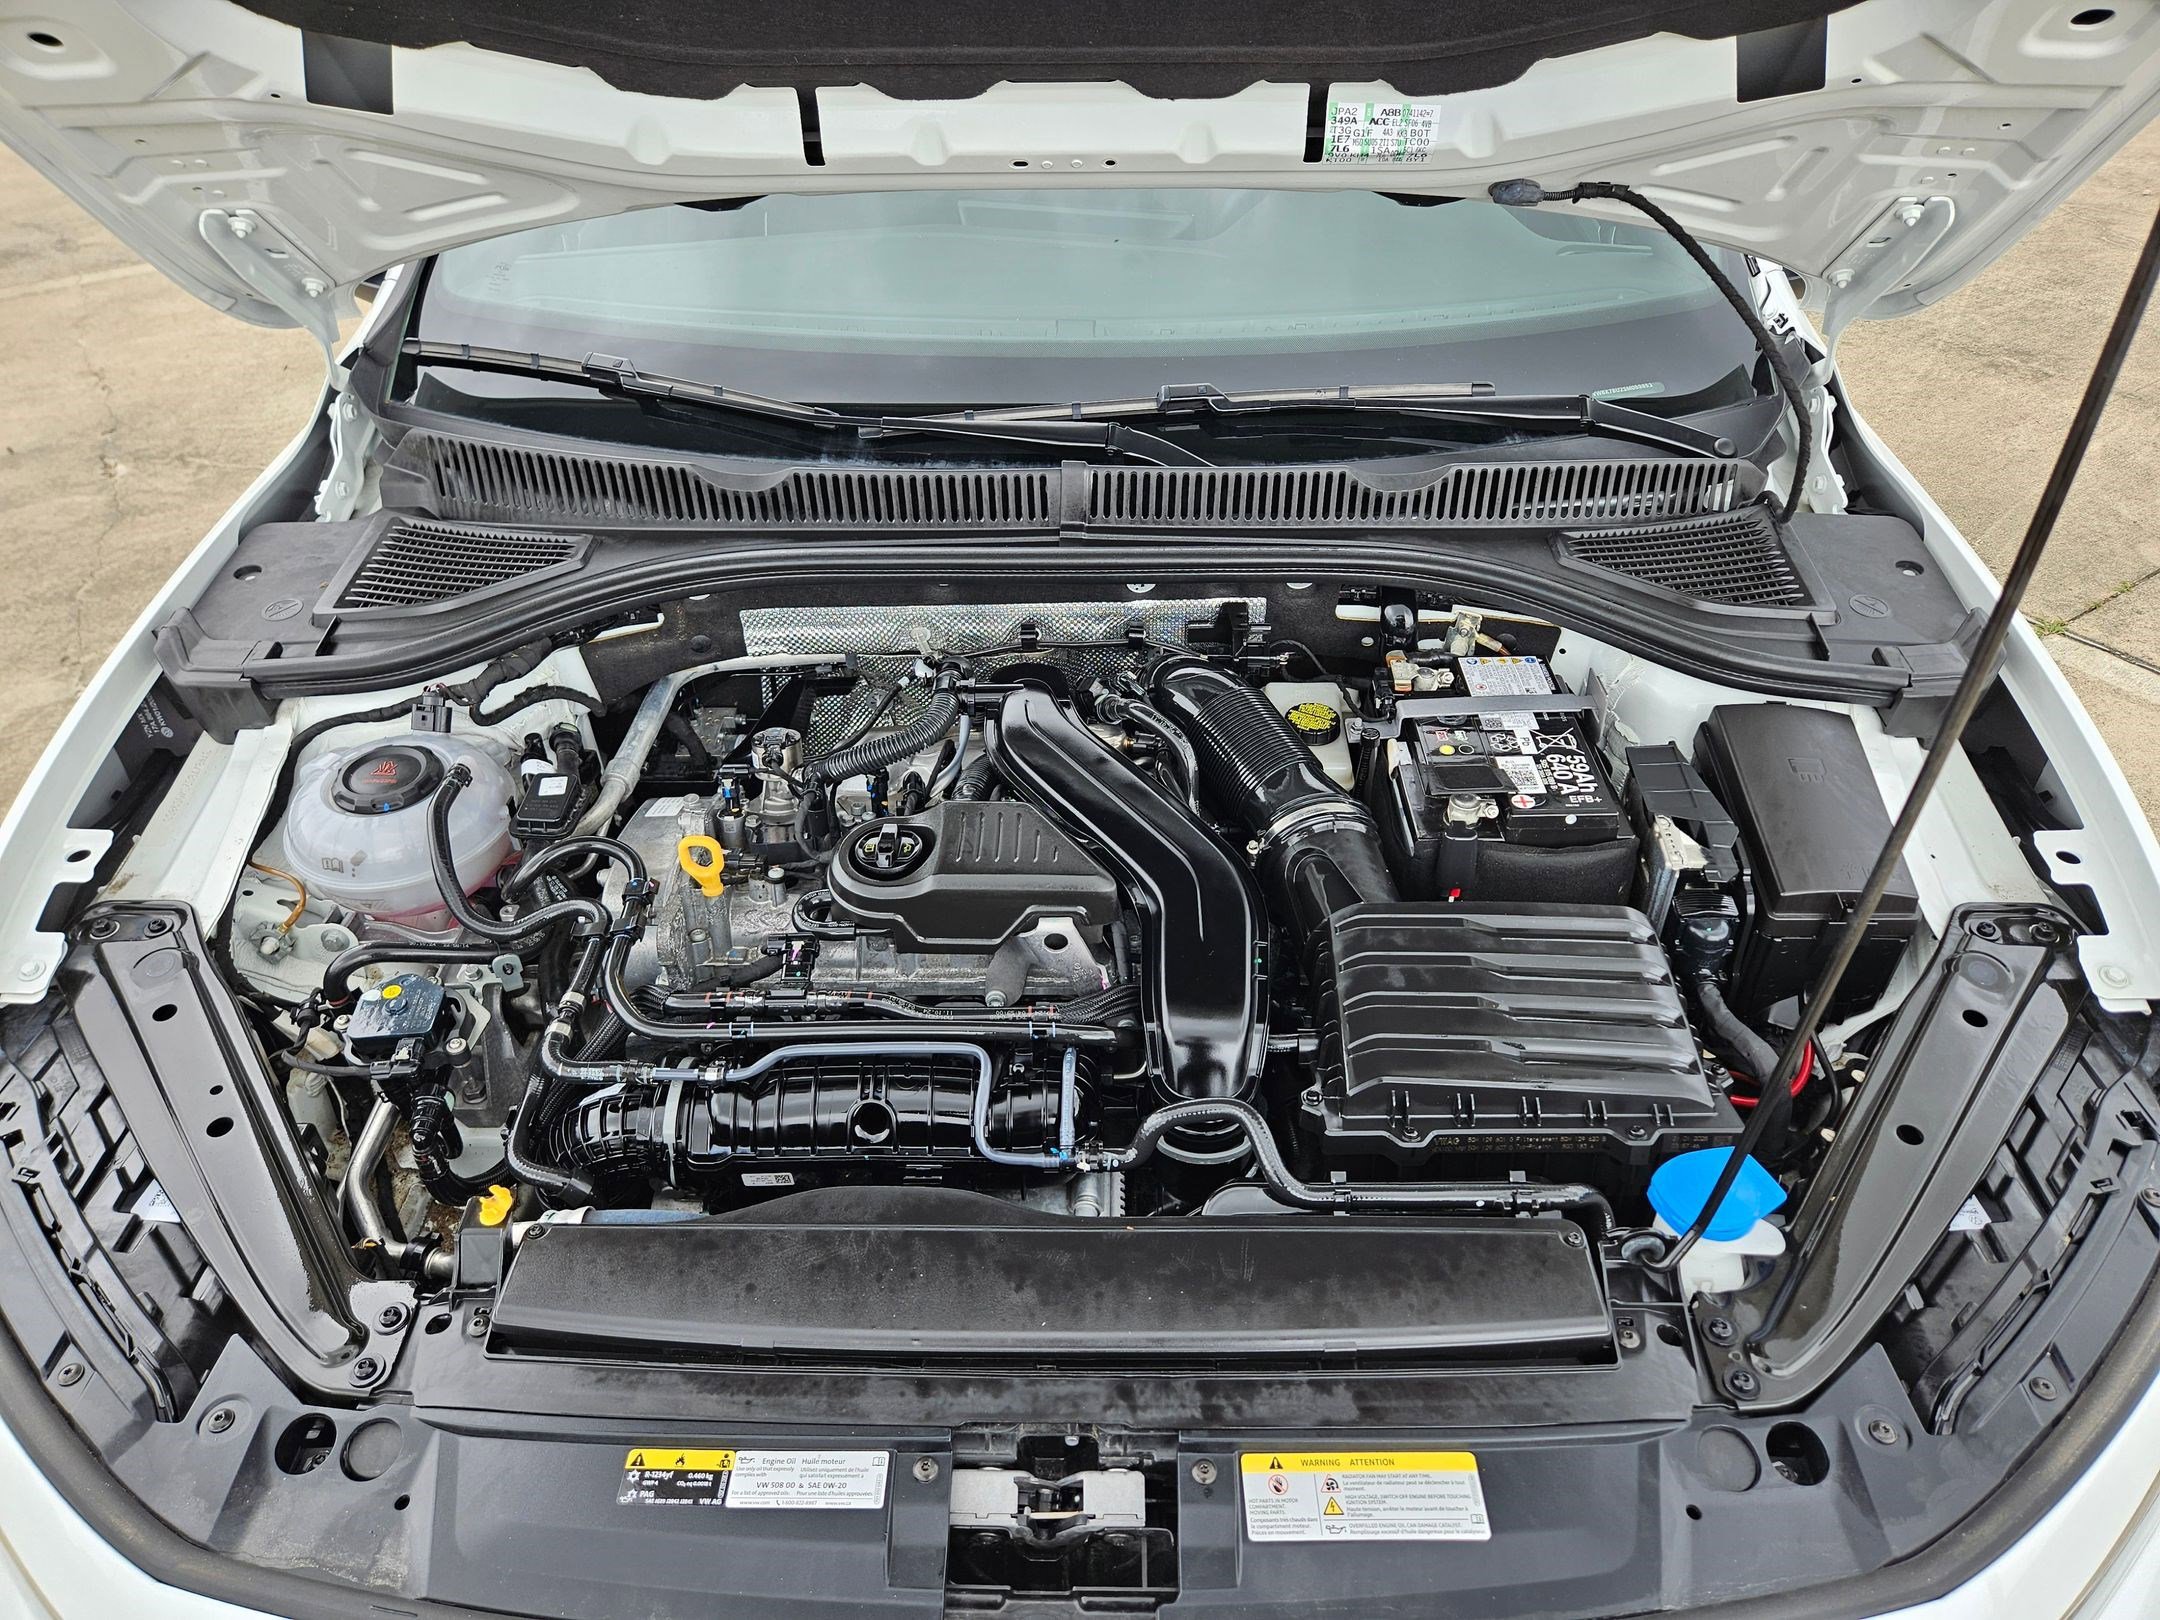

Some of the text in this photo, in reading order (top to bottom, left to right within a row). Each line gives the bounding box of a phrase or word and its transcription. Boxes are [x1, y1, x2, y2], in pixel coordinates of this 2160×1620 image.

[1330, 116, 1358, 125] 349A
[1368, 117, 1390, 126] ACC
[1331, 135, 1351, 144] 1E7
[1330, 145, 1350, 153] 7L6
[1546, 754, 1573, 780] 640
[1566, 754, 1598, 793] 59Ah
[1557, 782, 1580, 795] A
[1569, 795, 1603, 804] EFB+
[762, 1457, 785, 1466] Engine
[787, 1457, 797, 1465] Oil
[801, 1457, 820, 1465] Huile
[1300, 1458, 1395, 1467] WARNING ATTENTION
[644, 1470, 674, 1480] R-1234yf
[706, 1472, 714, 1480] kg
[756, 1481, 769, 1489] VW
[771, 1481, 784, 1489] 508
[785, 1481, 796, 1489] 00
[639, 1490, 655, 1498] PAG
